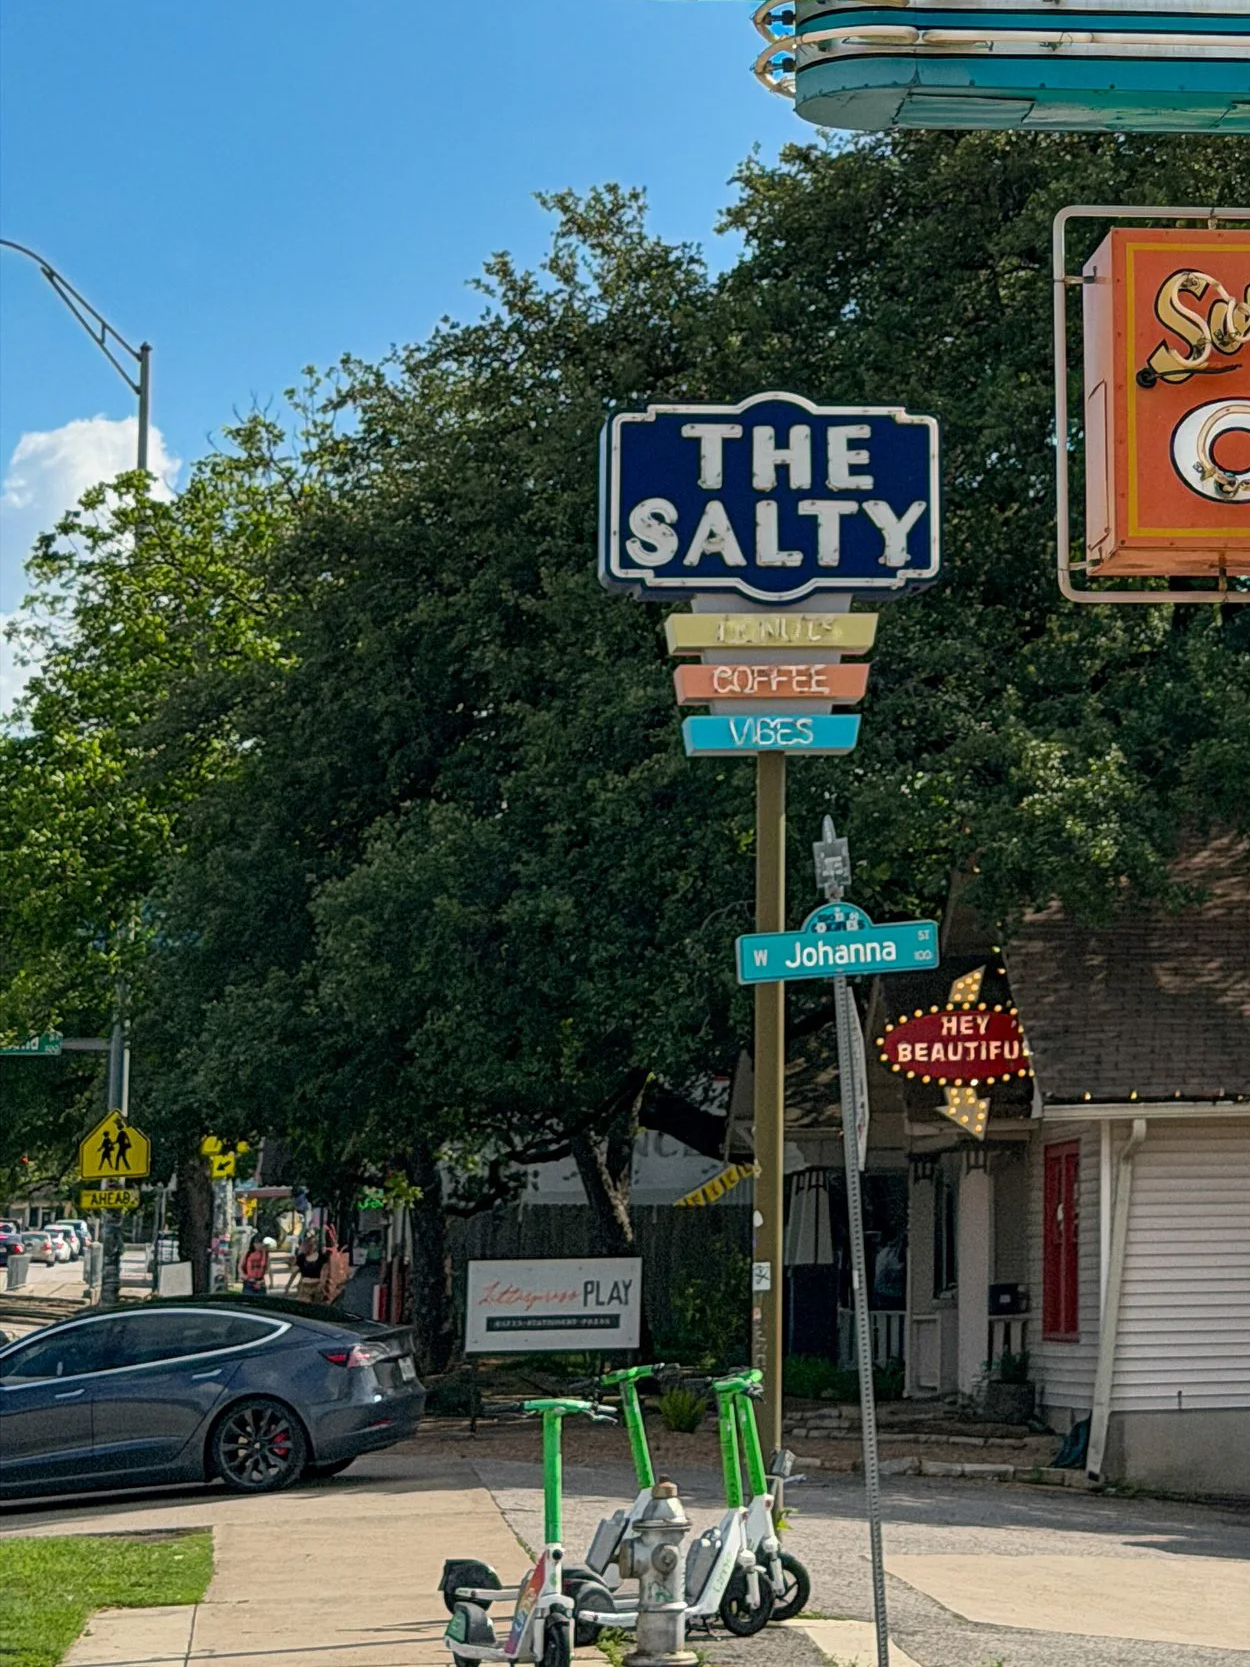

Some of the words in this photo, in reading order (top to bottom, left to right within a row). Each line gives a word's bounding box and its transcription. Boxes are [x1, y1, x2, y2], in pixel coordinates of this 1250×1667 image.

[681, 423, 874, 491] THE
[625, 498, 927, 566] SALTY
[713, 664, 830, 694] COFFEE
[729, 718, 814, 746] VIBES
[753, 949, 768, 967] W
[785, 941, 896, 968] Johanna
[917, 930, 930, 941] ST
[941, 1015, 990, 1036] HEY
[583, 1279, 633, 1307] PLAY
